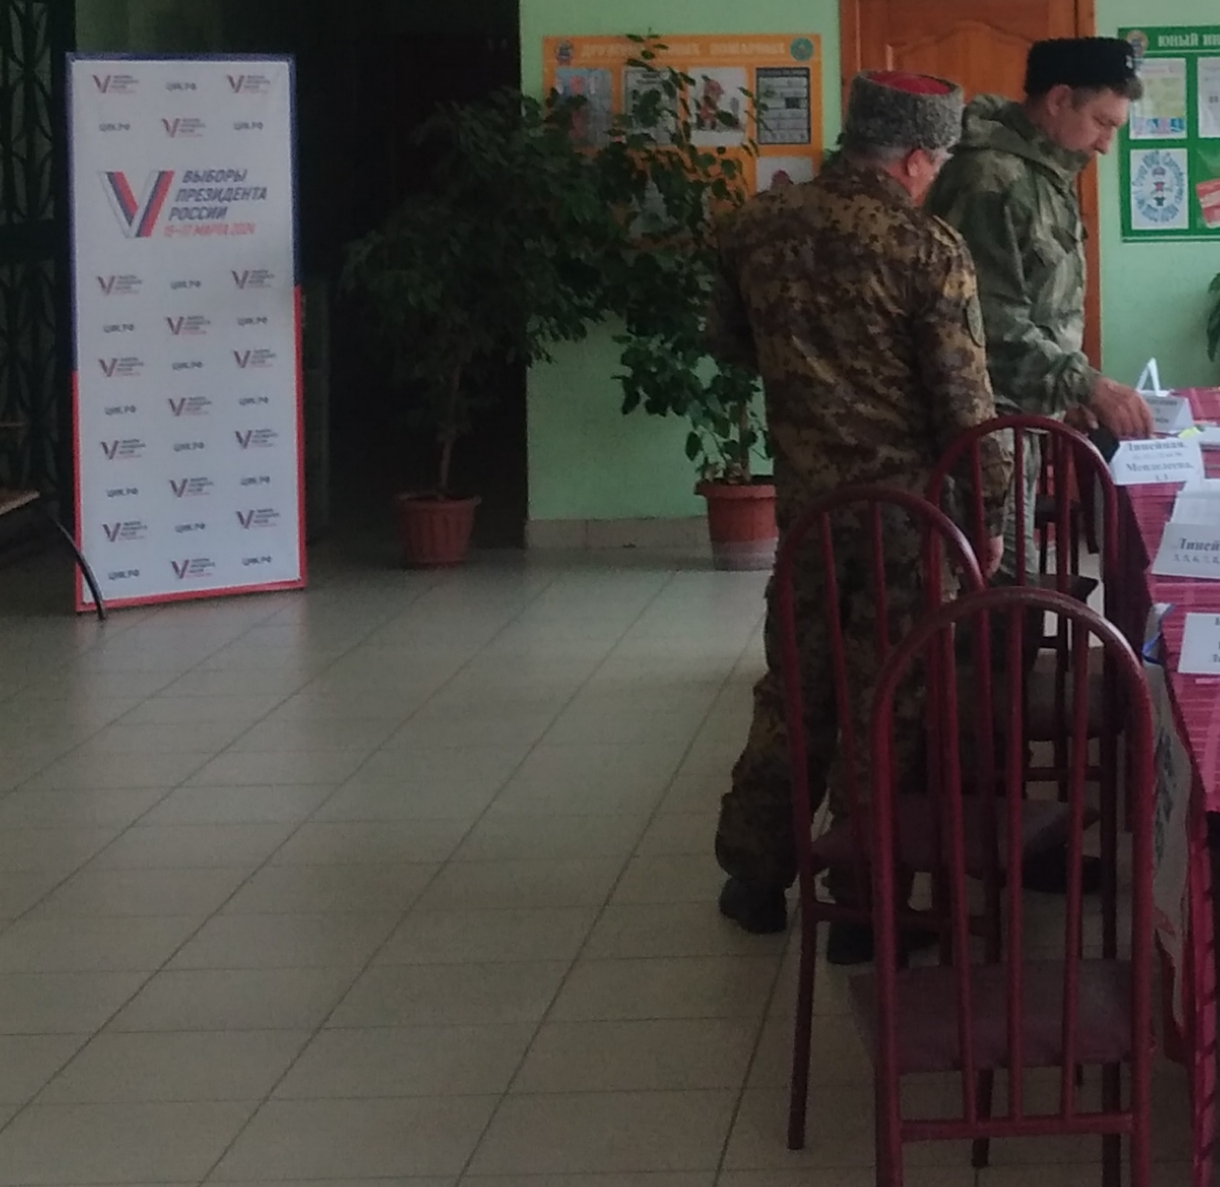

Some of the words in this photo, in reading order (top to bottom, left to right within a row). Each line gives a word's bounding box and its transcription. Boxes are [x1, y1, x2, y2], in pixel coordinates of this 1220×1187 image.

[1158, 32, 1198, 47] ЮНЫЙ
[182, 169, 249, 183] ВЫБОРЫ
[175, 186, 268, 203] ПРЕЗИДЕНТА
[168, 206, 229, 221] РОССИИ
